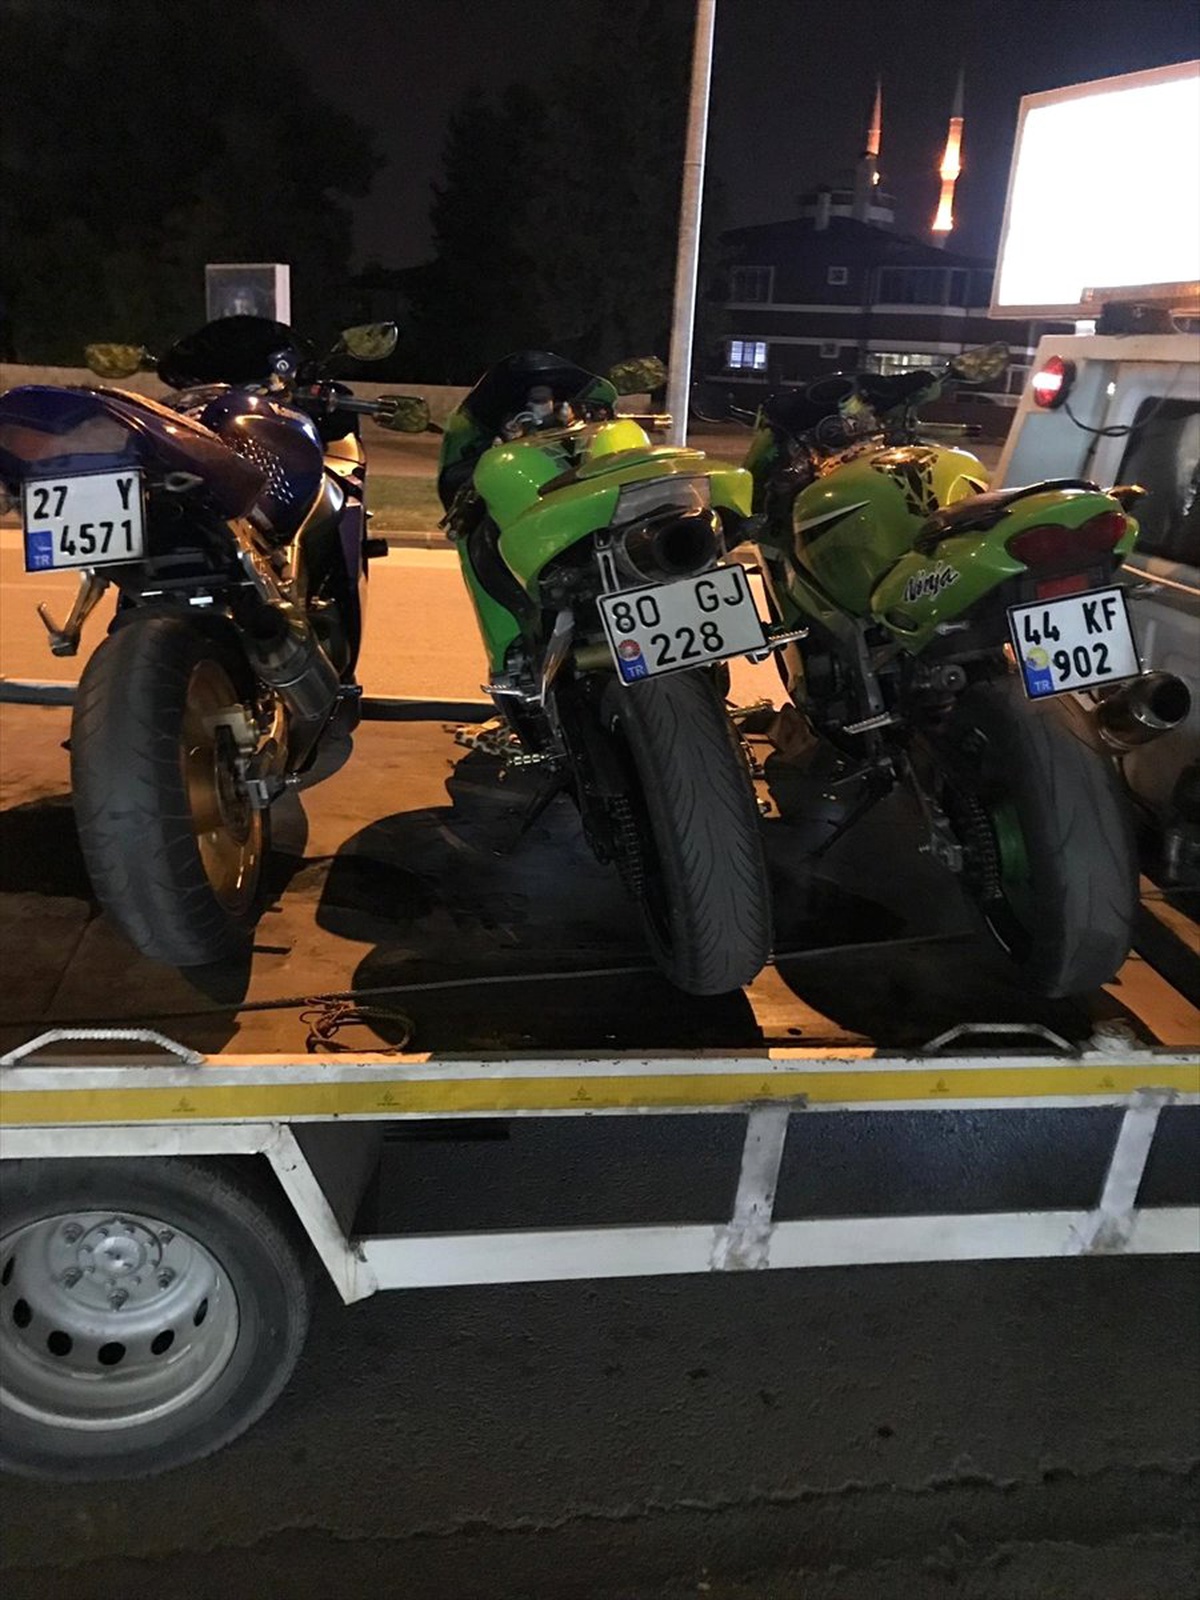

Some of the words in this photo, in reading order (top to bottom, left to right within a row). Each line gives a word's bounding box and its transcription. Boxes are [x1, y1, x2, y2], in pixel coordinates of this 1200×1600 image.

[33, 485, 68, 520] 27
[116, 478, 133, 510] Y
[60, 520, 133, 556] 4571
[34, 555, 50, 566] TR
[903, 560, 959, 602] Ninja
[612, 595, 660, 634] 80
[694, 573, 744, 613] GJ
[1024, 611, 1060, 645] 44
[1082, 597, 1116, 634] KF
[651, 621, 724, 667] 228
[1053, 642, 1112, 682] 902
[628, 664, 646, 677] TR
[1034, 681, 1050, 691] TR
